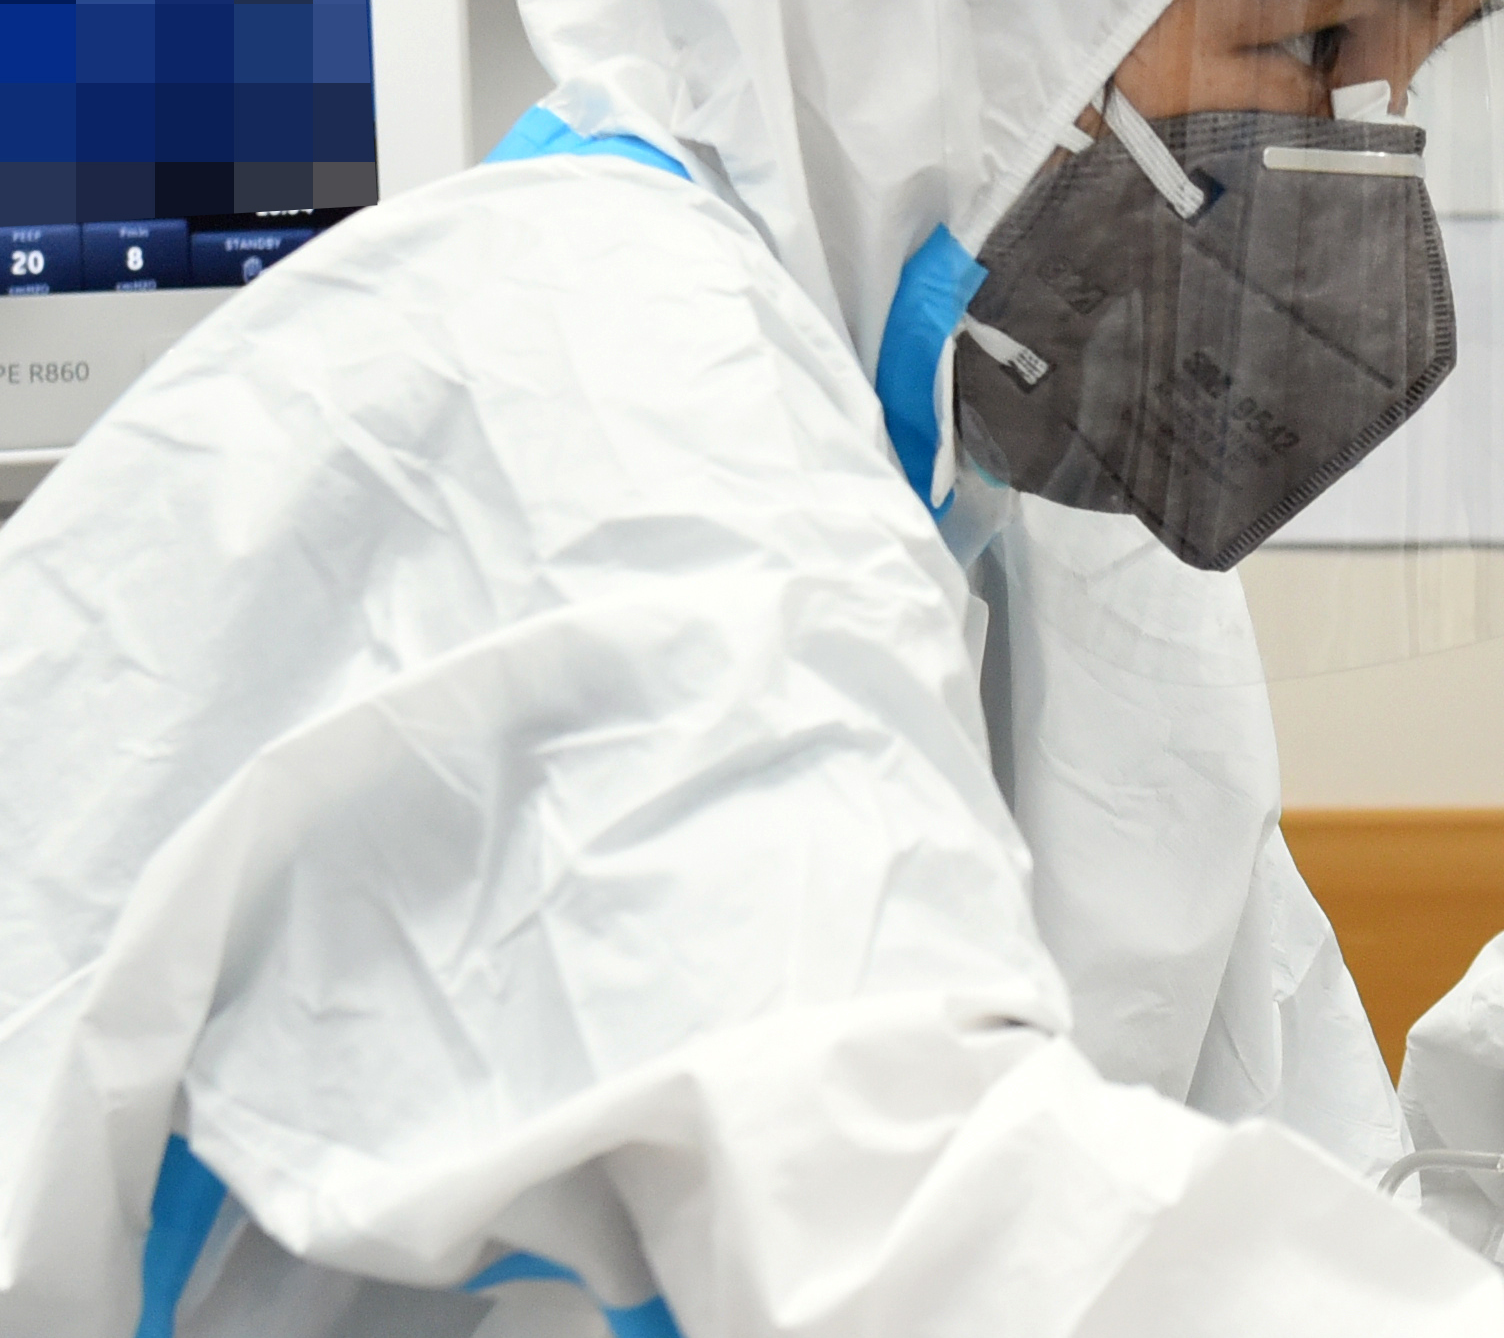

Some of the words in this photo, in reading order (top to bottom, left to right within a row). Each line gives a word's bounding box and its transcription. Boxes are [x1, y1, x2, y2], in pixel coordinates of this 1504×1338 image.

[225, 238, 281, 251] STANDBY
[10, 250, 45, 276] 20
[126, 246, 144, 271] 8
[29, 362, 90, 385] R860
